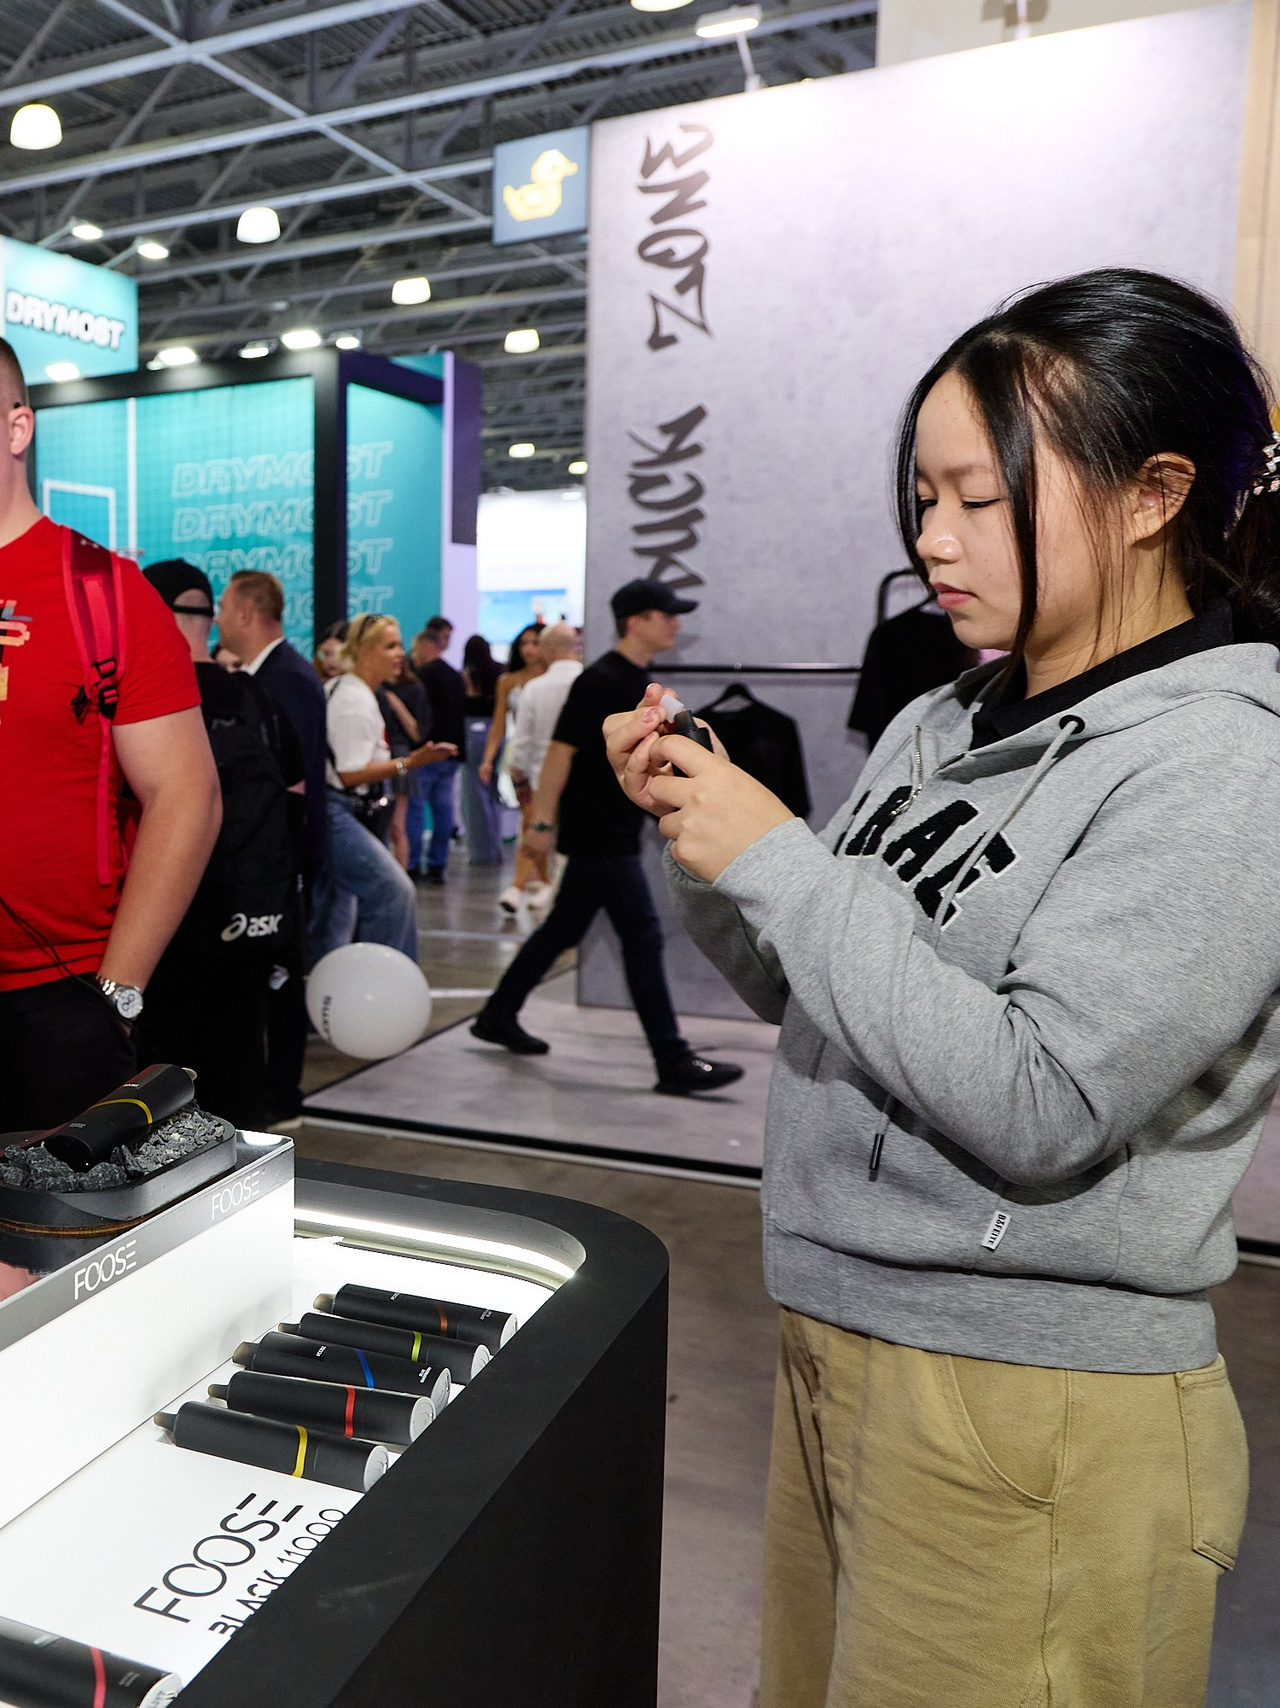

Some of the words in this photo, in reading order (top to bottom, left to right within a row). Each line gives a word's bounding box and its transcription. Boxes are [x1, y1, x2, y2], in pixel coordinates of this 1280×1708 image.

[635, 124, 715, 352] ZONE
[5, 289, 125, 351] DRYMOST
[626, 403, 707, 592] DUCK
[212, 1170, 260, 1220] FOOSE
[74, 1240, 137, 1300] FOOSE
[133, 1492, 304, 1624] FOOSE
[276, 1508, 347, 1566] 11000
